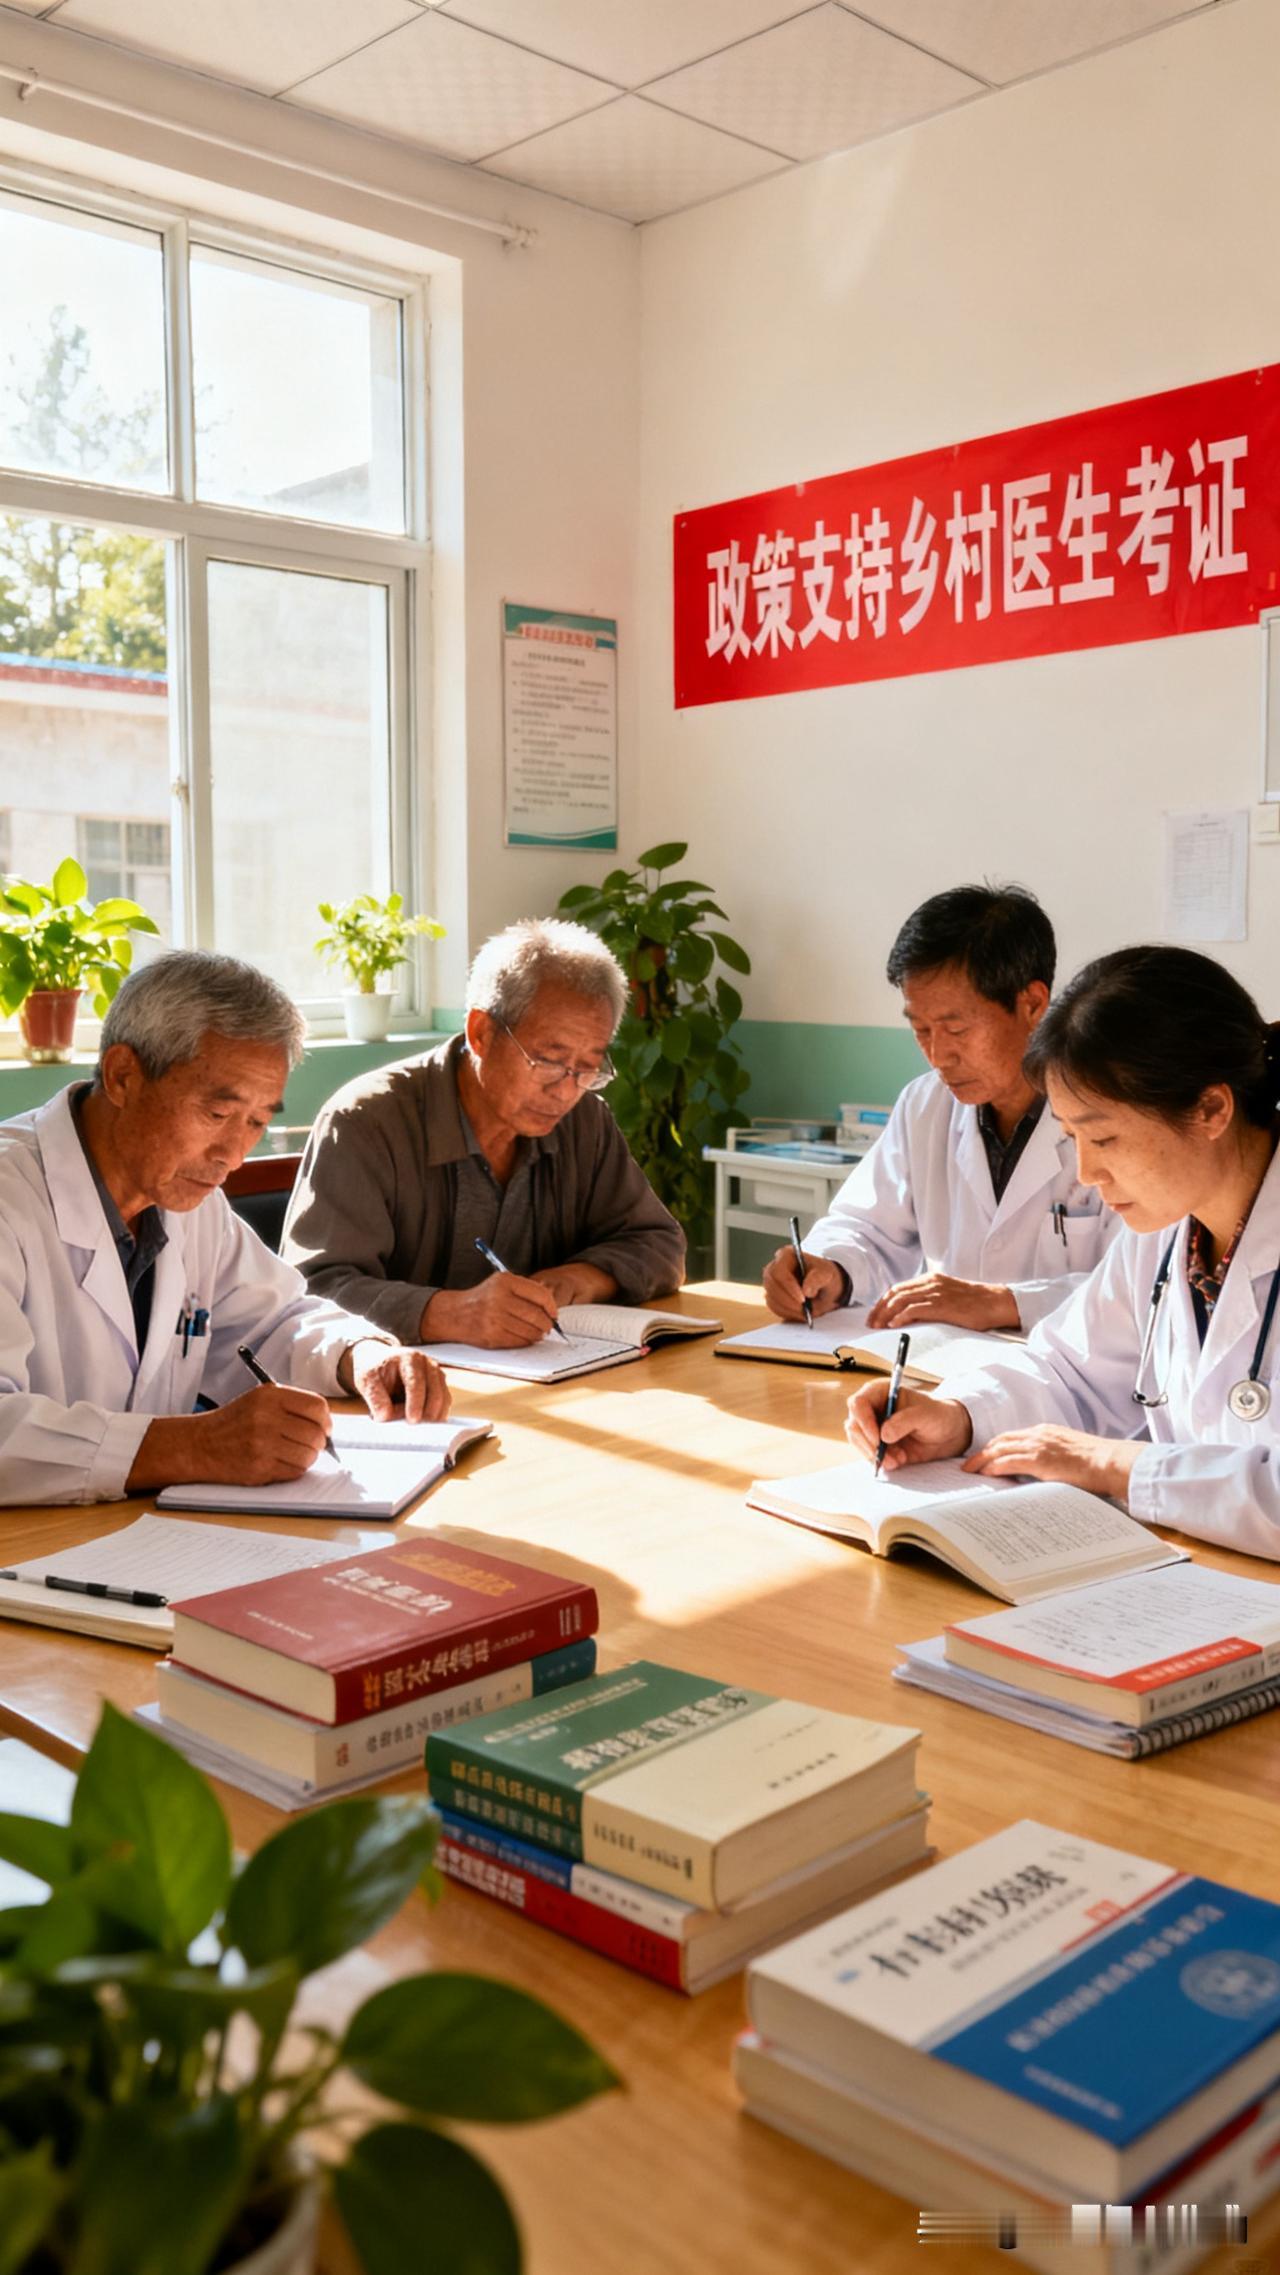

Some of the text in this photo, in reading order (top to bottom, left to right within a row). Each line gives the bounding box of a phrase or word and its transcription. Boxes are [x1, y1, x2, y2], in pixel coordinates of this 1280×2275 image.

[705, 435, 1249, 665] 政策支持乡村医生考证
